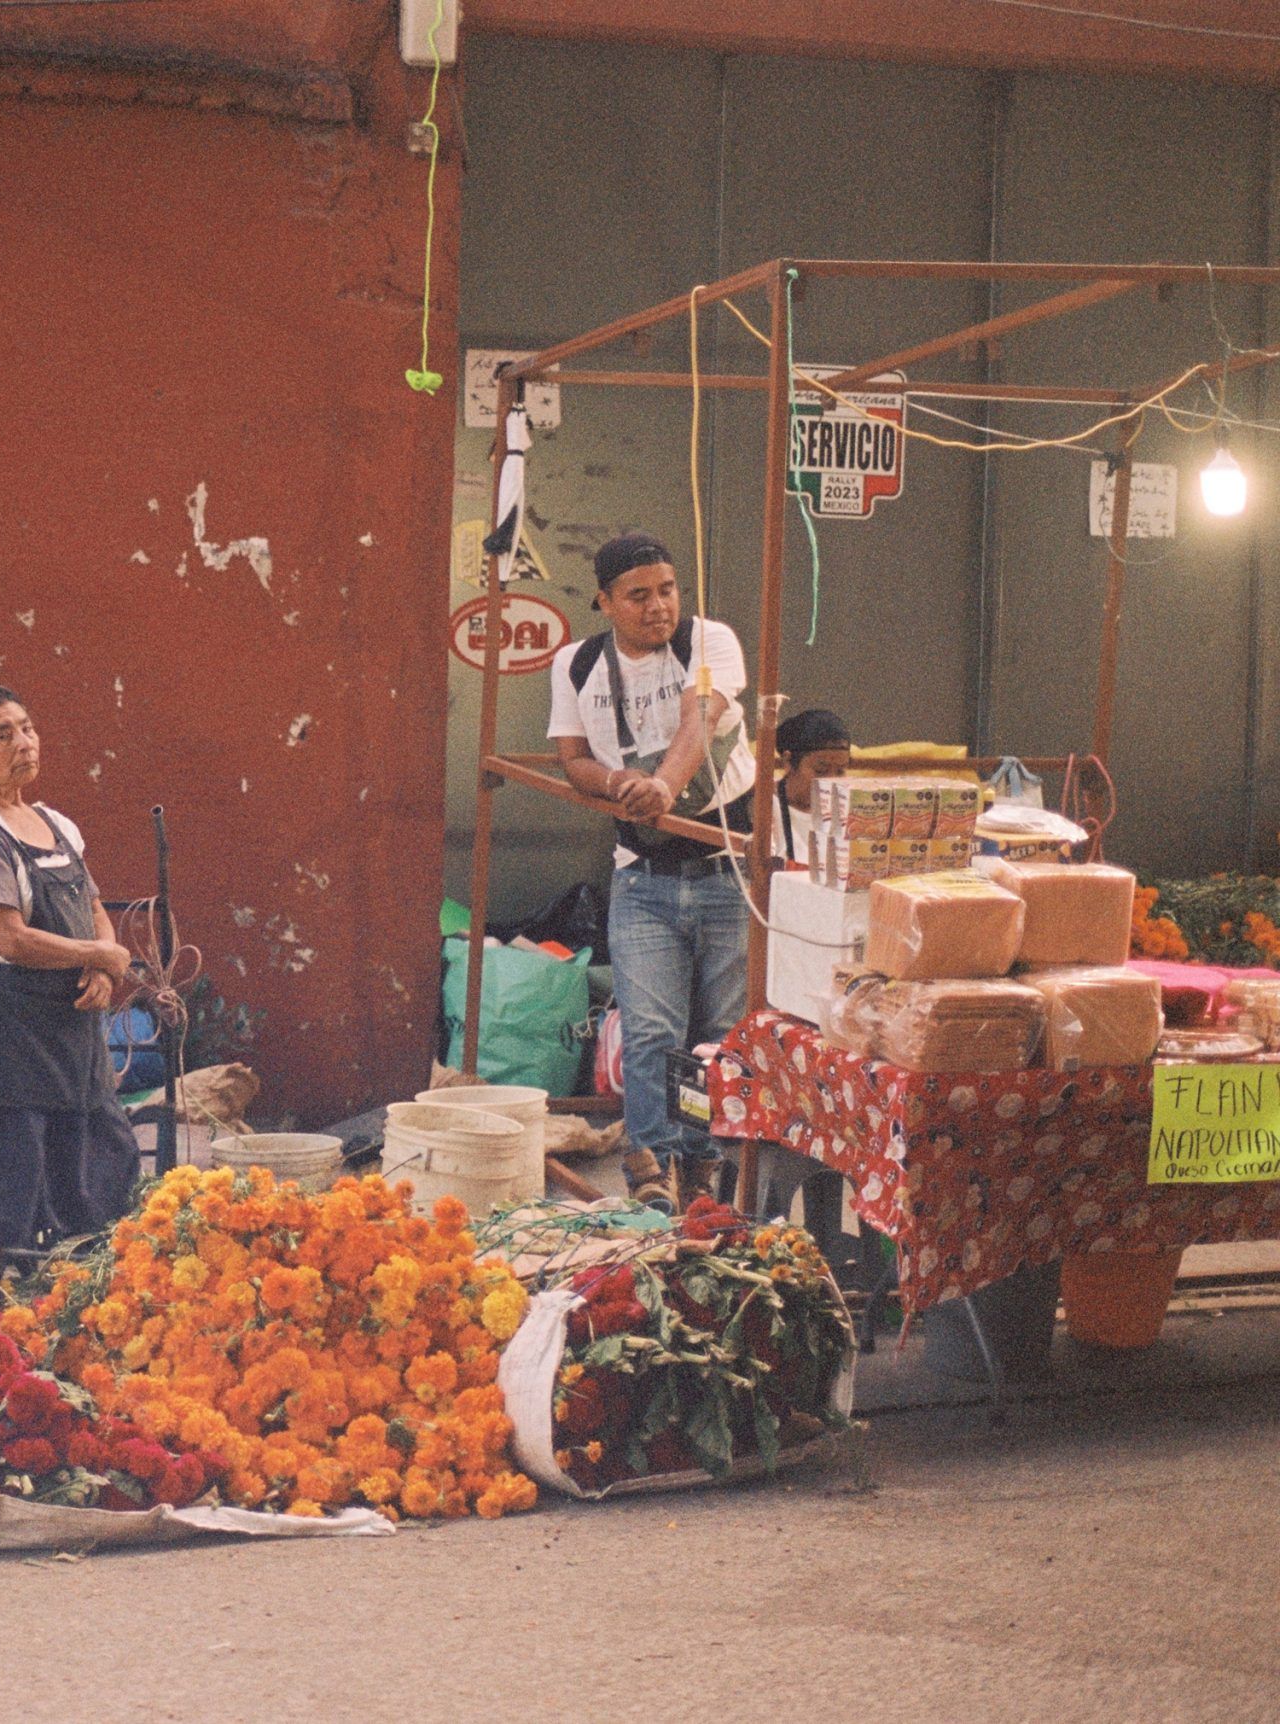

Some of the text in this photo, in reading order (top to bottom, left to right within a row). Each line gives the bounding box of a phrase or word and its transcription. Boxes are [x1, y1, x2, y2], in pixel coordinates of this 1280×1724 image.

[792, 419, 896, 472] SERVICIO
[824, 486, 860, 498] 2023
[828, 476, 857, 484] RALLY
[1165, 1072, 1263, 1117] FLAN
